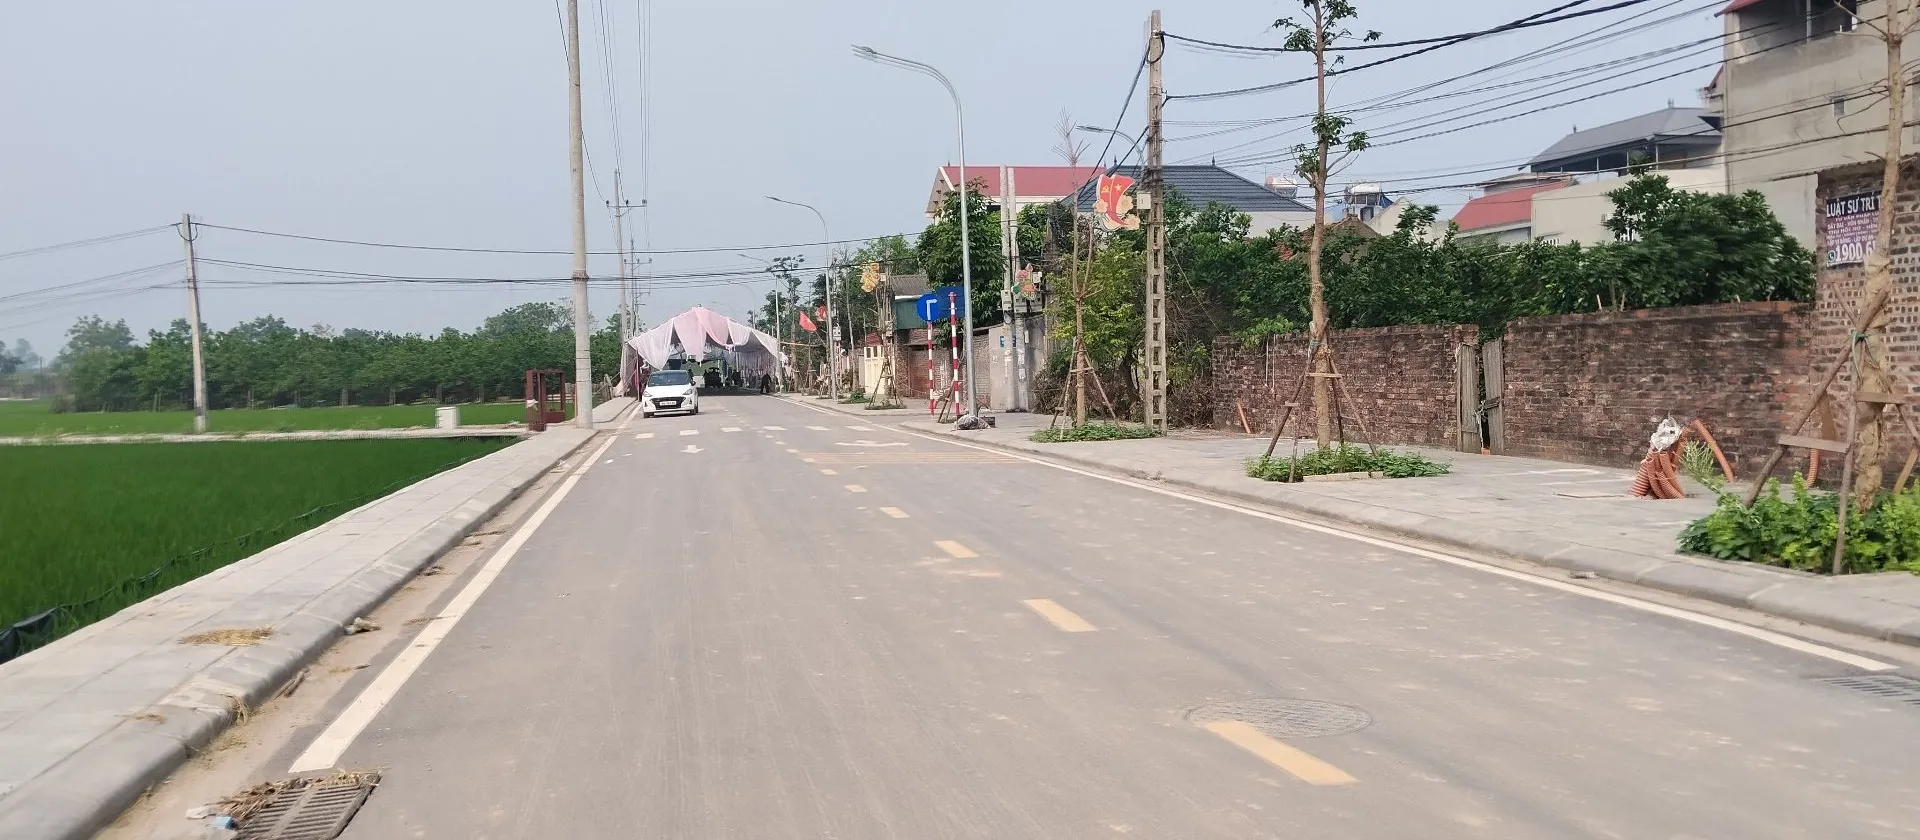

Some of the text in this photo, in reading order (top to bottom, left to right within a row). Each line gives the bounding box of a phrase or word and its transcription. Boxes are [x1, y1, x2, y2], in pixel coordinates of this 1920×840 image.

[1826, 198, 1846, 218] LUẬT
[1847, 197, 1859, 214] SƯ
[1860, 192, 1875, 211] TRÍ
[1836, 242, 1862, 262] 1900
